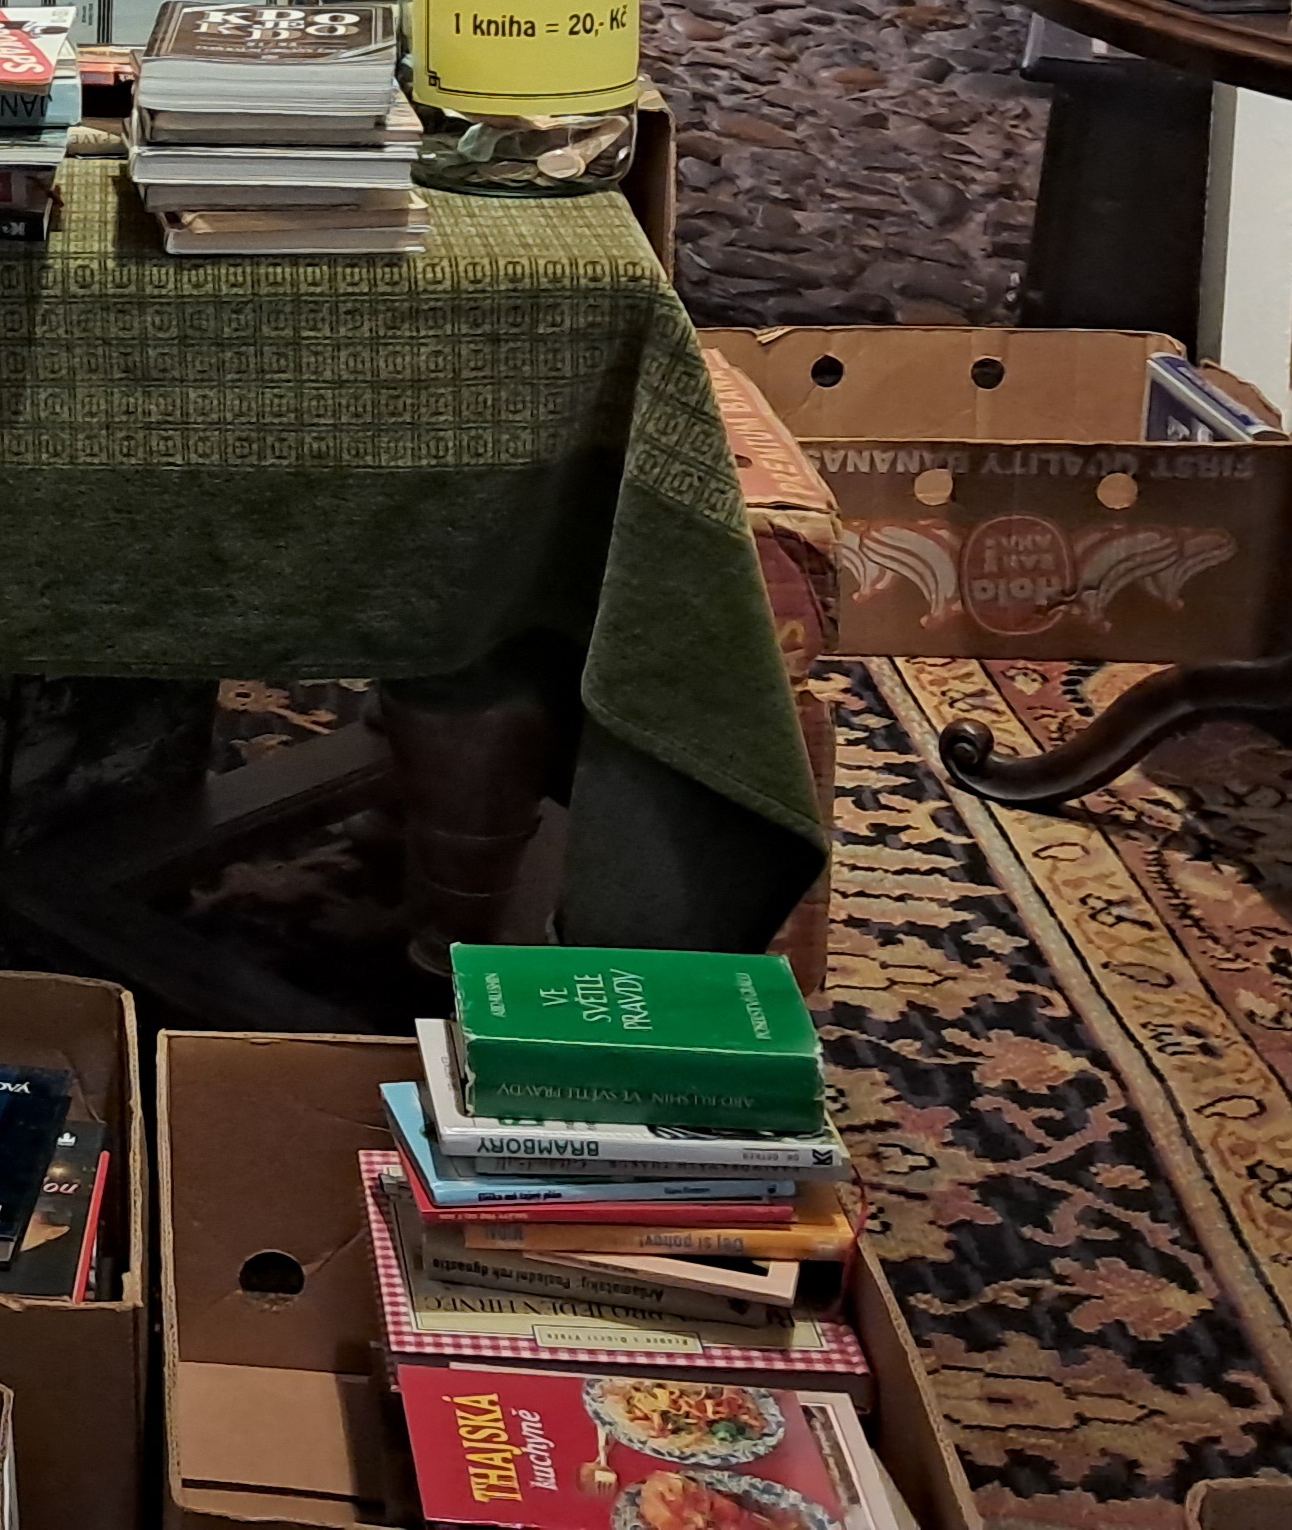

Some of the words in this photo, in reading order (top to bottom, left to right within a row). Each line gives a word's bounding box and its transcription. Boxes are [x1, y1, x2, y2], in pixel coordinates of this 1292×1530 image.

[472, 13, 537, 39] kniha
[545, 21, 559, 33] =
[609, 5, 628, 31] Kč
[0, 92, 53, 118] JAN
[1150, 456, 1254, 479] FIRST
[540, 986, 568, 1007] VE
[574, 973, 612, 1022] SVĚTLE
[610, 968, 654, 1032] PRAVDY
[495, 1082, 563, 1099] PRAVDY
[476, 1136, 600, 1158] BRAMBORY
[441, 1391, 522, 1507] THAJSKÁ
[520, 1408, 560, 1493] kuchyně
